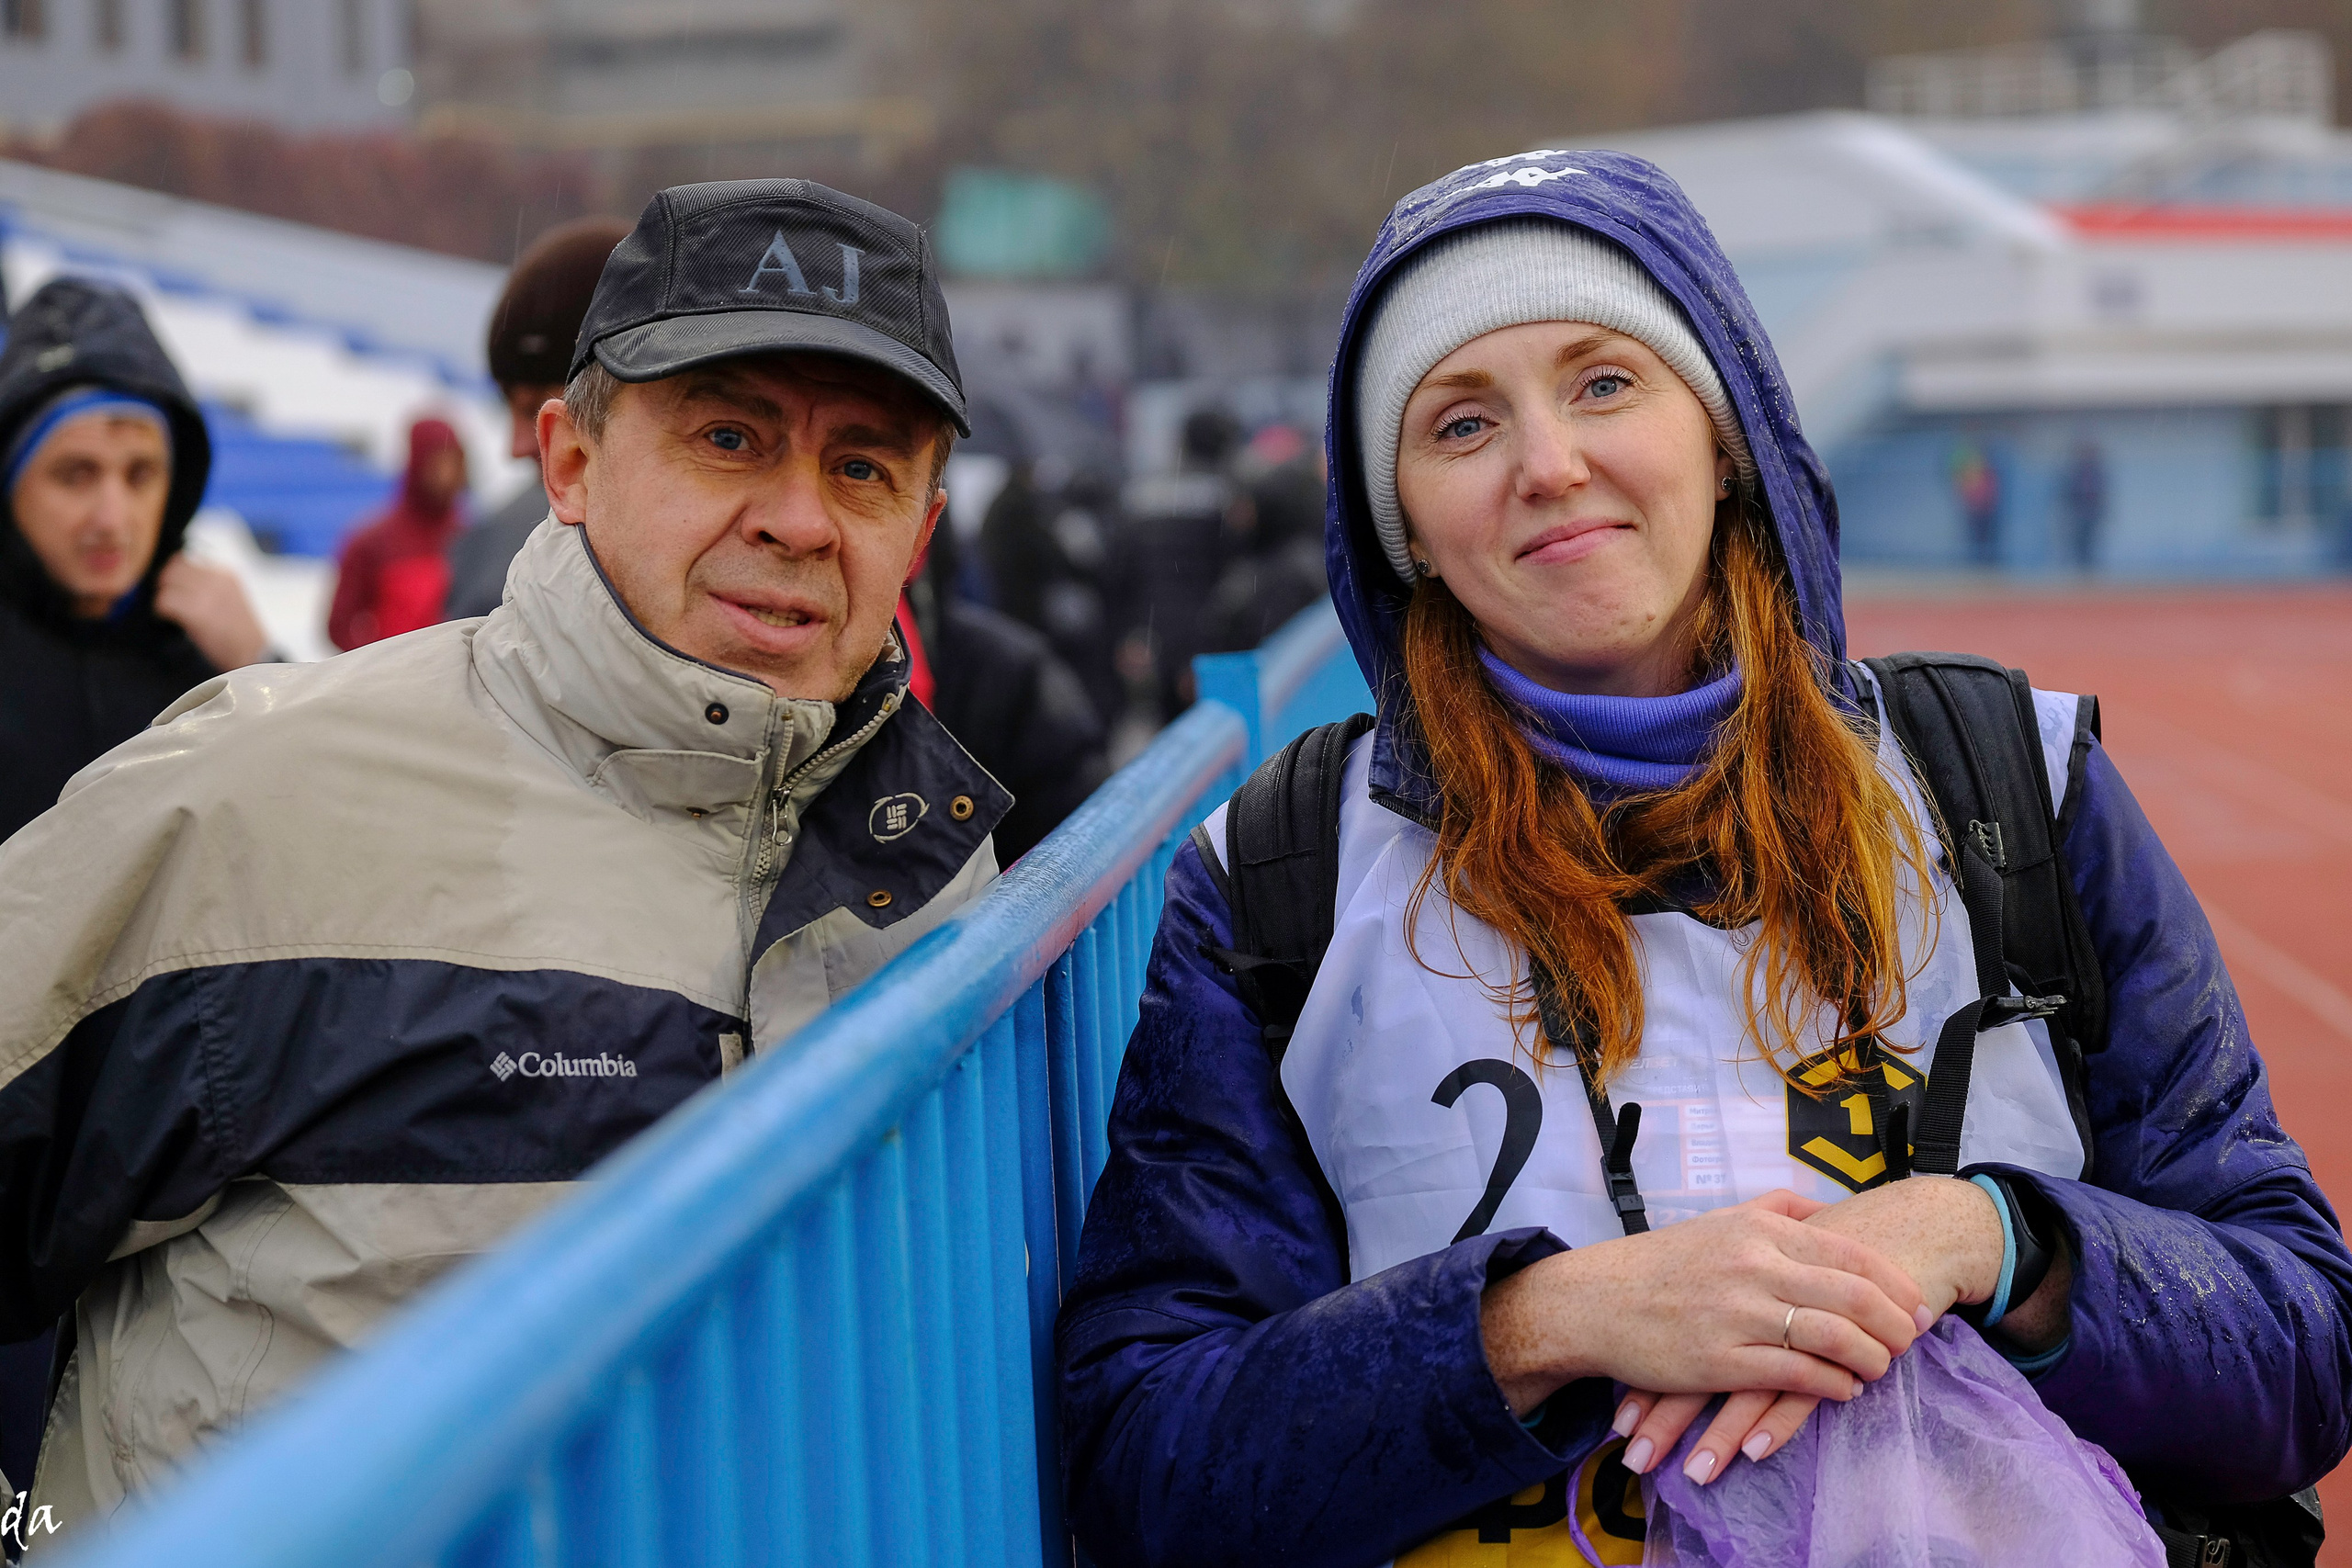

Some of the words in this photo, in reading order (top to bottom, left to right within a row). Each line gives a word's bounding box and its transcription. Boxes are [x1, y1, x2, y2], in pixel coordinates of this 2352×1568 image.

[738, 229, 865, 304] AJ
[517, 1051, 638, 1077] Columbia
[1646, 1084, 1705, 1094] ПРЕДСТАВИ
[1840, 1093, 1873, 1135] 1
[1430, 1058, 1543, 1246] 2
[1691, 1155, 1725, 1165] Фотогр
